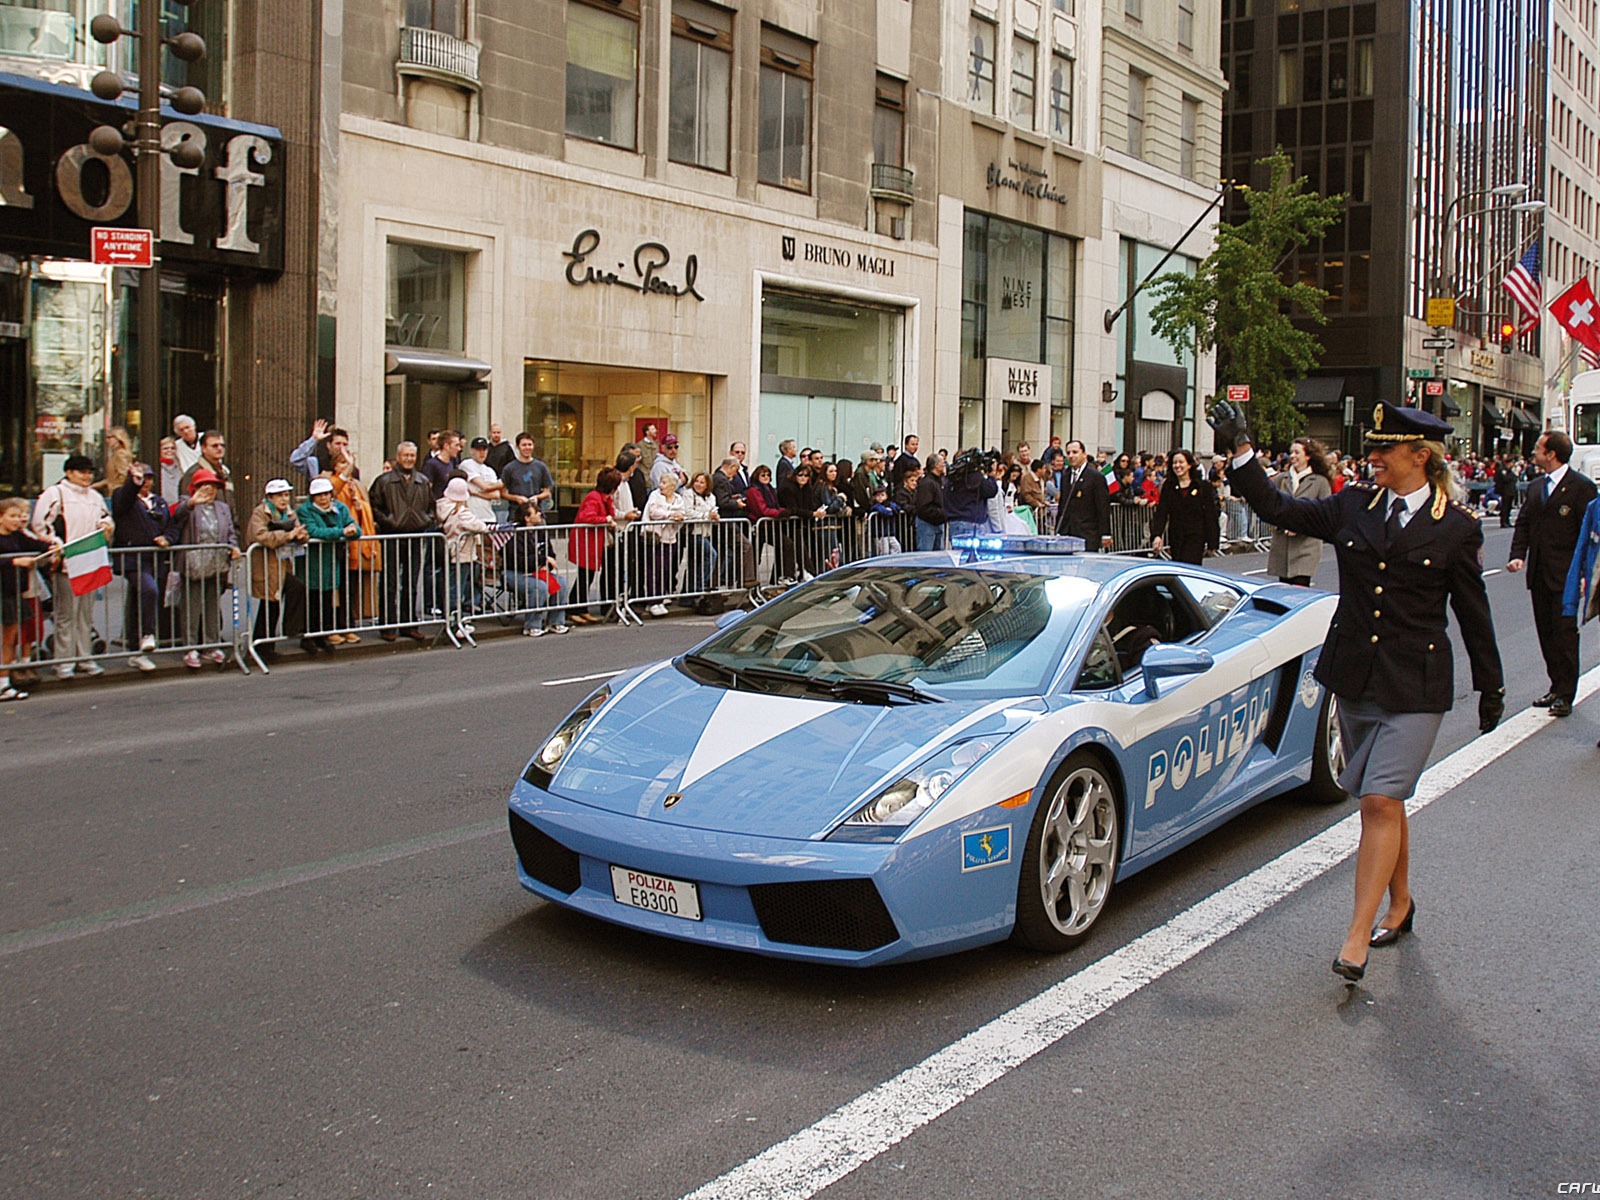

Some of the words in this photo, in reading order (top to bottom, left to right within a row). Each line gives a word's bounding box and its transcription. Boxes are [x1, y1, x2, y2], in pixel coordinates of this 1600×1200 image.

[96, 231, 108, 240] NO
[111, 232, 148, 242] STANDING
[103, 241, 142, 252] ANYTIME
[804, 243, 850, 268] BRUNO
[856, 254, 895, 277] MAGLI
[1003, 276, 1032, 295] NINE
[1001, 293, 1031, 309] WEST
[1009, 367, 1038, 381] NINE
[1009, 380, 1037, 396] WEST
[1144, 687, 1270, 810] POLIZIA
[628, 872, 676, 894] POLIZIA
[630, 887, 678, 914] E8300
